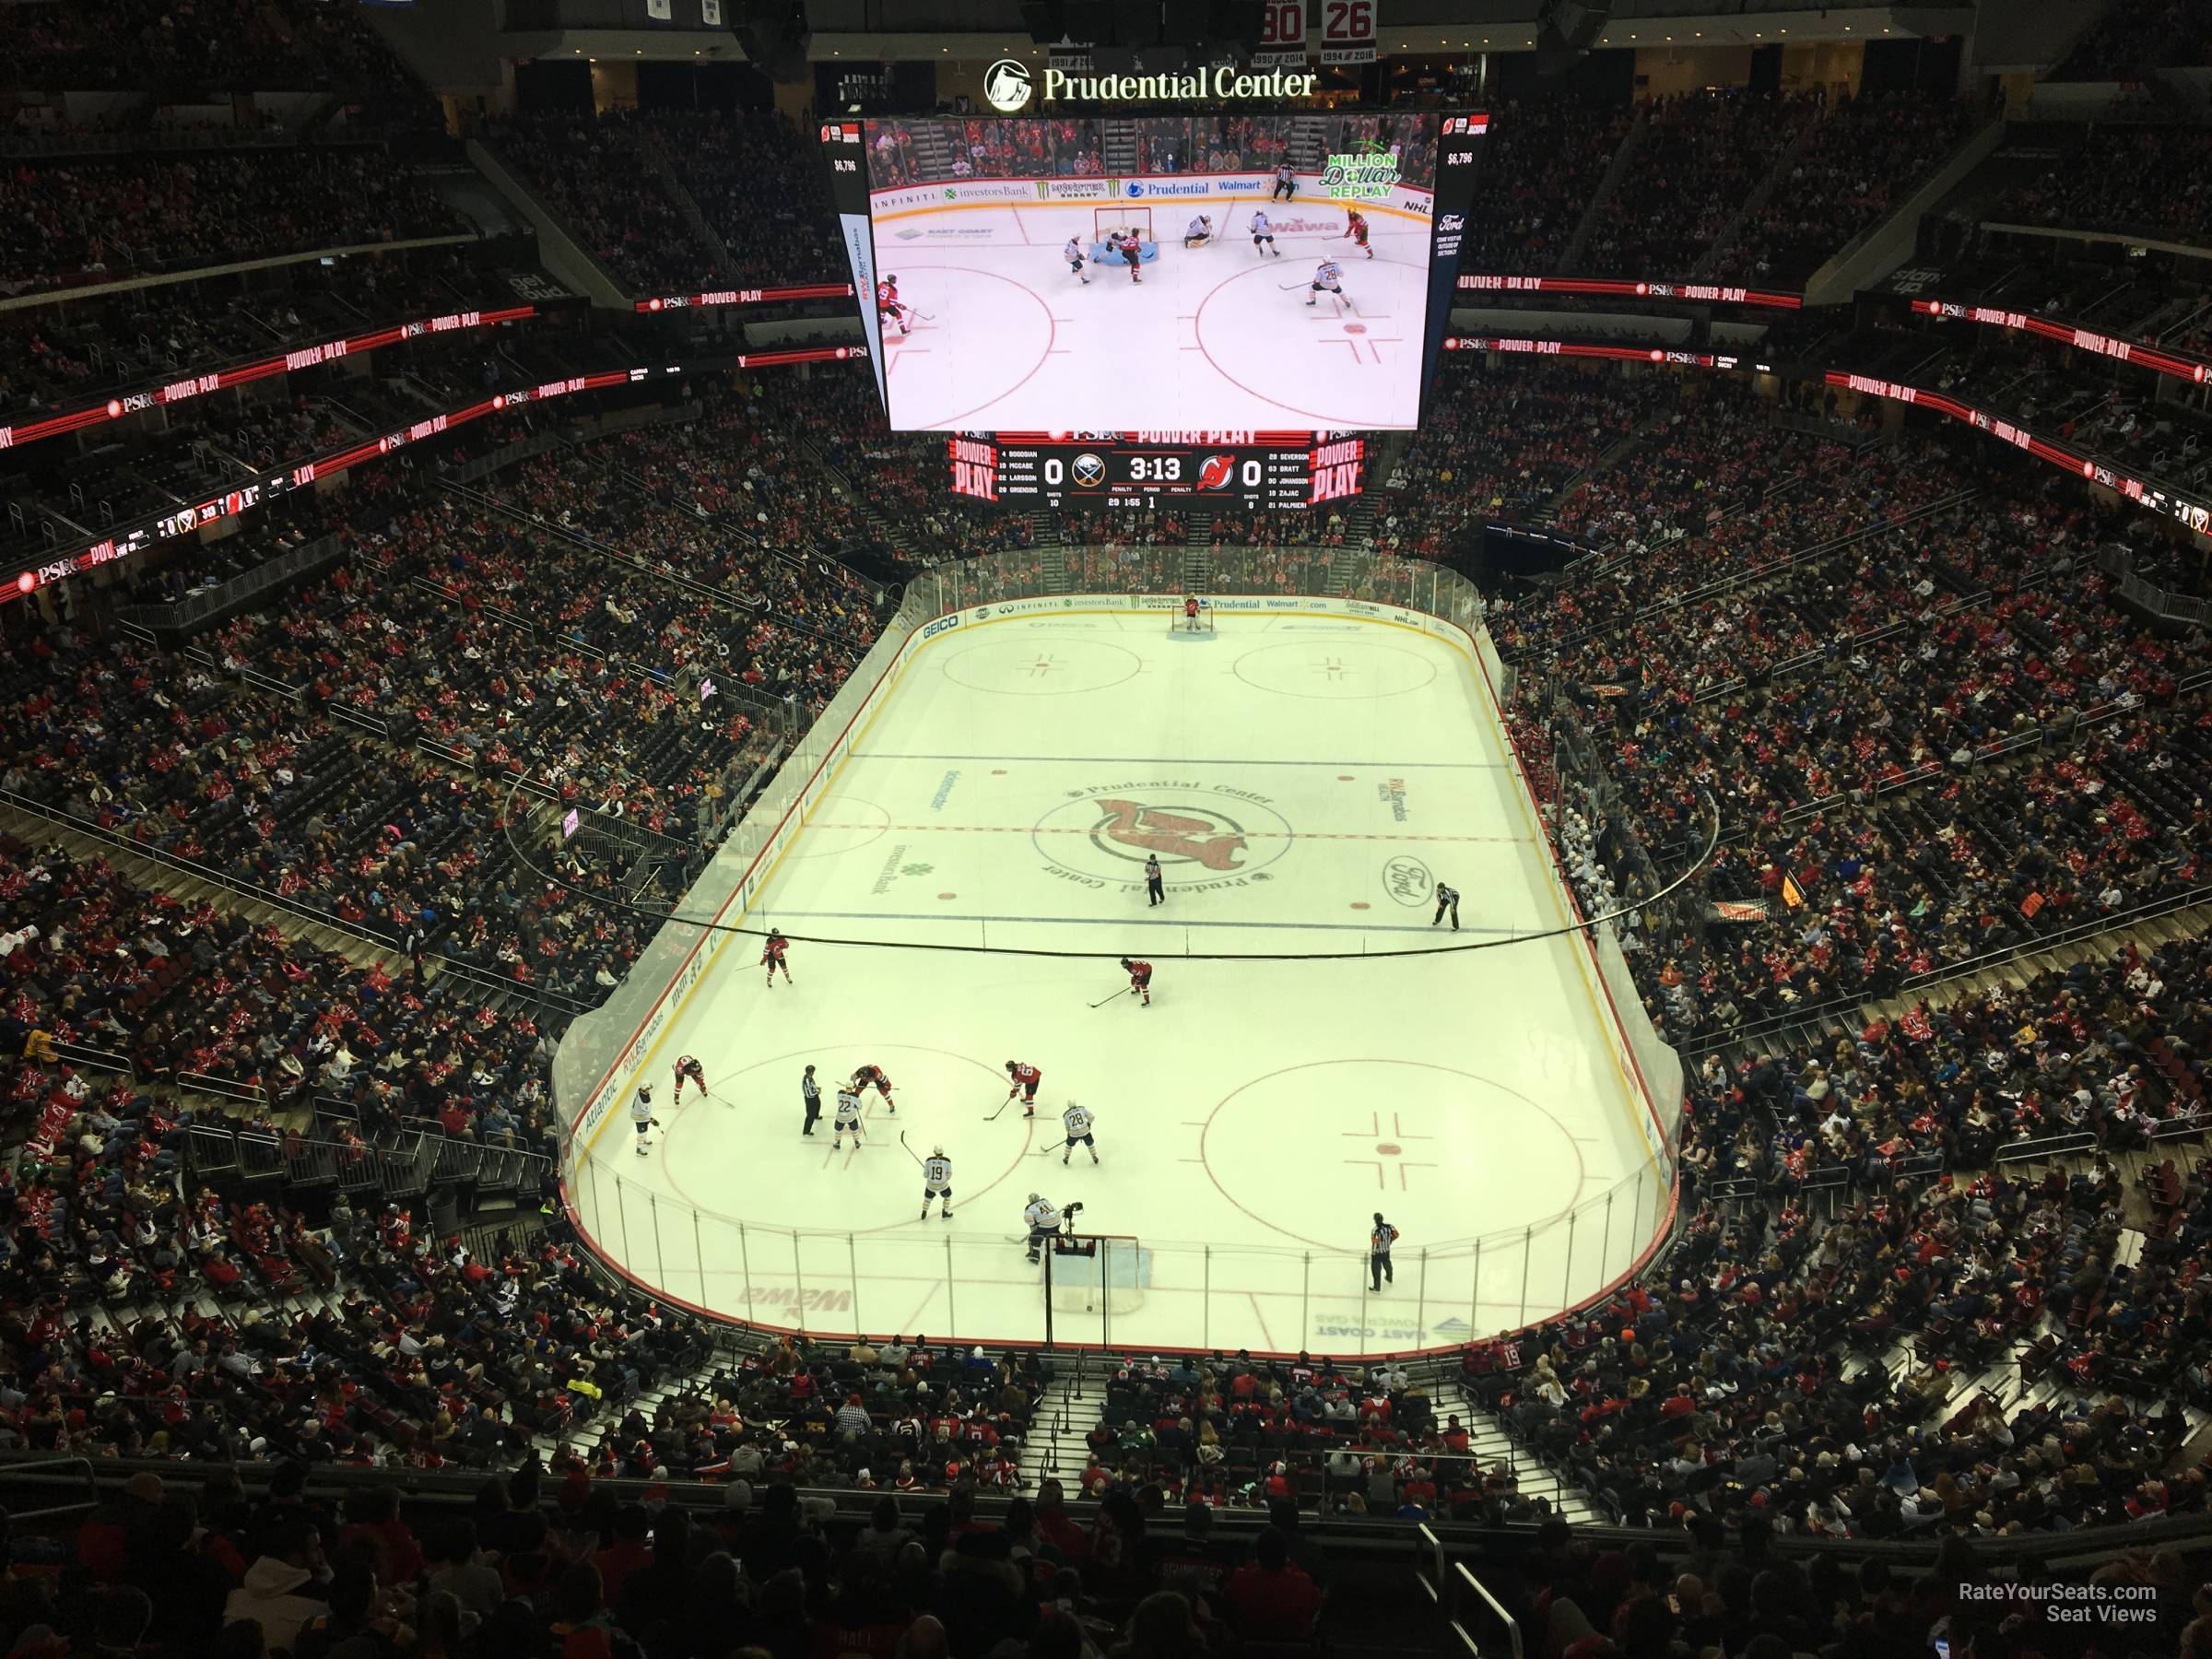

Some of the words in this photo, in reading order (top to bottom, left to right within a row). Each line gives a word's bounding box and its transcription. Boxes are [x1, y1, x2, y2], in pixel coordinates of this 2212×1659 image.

[1327, 2, 1371, 39] 26
[1253, 53, 1273, 64] 1990
[1284, 51, 1304, 63] 2014
[1323, 52, 1342, 62] 1994
[1354, 51, 1374, 60] 2016
[1043, 65, 1208, 100] Prudential
[1215, 65, 1317, 98] Center
[834, 159, 856, 172] $6,796
[1328, 153, 1397, 168] MILLION
[1447, 152, 1473, 166] $6,796
[1319, 166, 1402, 185] Dollar
[1147, 182, 1209, 194] Prudential
[1218, 181, 1261, 191] Walmart
[1329, 185, 1393, 199] REPLAY
[875, 193, 936, 209] INFINITI
[1439, 214, 1465, 231] Ford
[701, 291, 736, 305] POWER
[741, 289, 762, 302] PLAY
[1685, 285, 1719, 300] POWER
[1722, 288, 1747, 301] PLAY
[432, 315, 459, 331] POWER
[463, 312, 479, 327] PLAY
[1976, 308, 2006, 324] POWER
[2007, 312, 2027, 329] PLAY
[1499, 338, 1533, 353] POWER
[1537, 340, 1561, 354] PLAY
[164, 380, 197, 402] POWER
[200, 373, 218, 393] PLAY
[538, 382, 566, 397] POWER
[569, 377, 585, 391] PLAY
[1137, 430, 1201, 443] POWER
[1207, 430, 1257, 444] PLAY
[955, 440, 992, 466] POWER
[1316, 441, 1358, 467] POWER
[1044, 459, 1064, 485] 0
[1130, 457, 1181, 480] 3:13
[1242, 460, 1262, 487] 0
[955, 462, 994, 500] PLAY
[1312, 461, 1359, 503] PLAY
[1050, 499, 1059, 507] 10
[1124, 499, 1141, 507] 1:55
[1148, 497, 1155, 509] 1
[1018, 601, 1058, 610] INFINITI
[1214, 599, 1260, 609] Prudential
[1266, 599, 1299, 608] Walmart
[924, 615, 959, 639] GEICO
[1087, 779, 1201, 794] Prudential
[1213, 783, 1275, 806] Center
[1042, 865, 1106, 889] Center
[1391, 864, 1427, 898] Ford
[585, 1078, 618, 1133] Atlantic
[838, 1100, 851, 1113] 22
[1068, 1112, 1085, 1127] 28
[930, 1166, 943, 1180] 19
[1039, 1205, 1054, 1216] 41
[1316, 1325, 1375, 1338] COAST
[1381, 1329, 1427, 1340] EAST
[1504, 1348, 1521, 1366] 19
